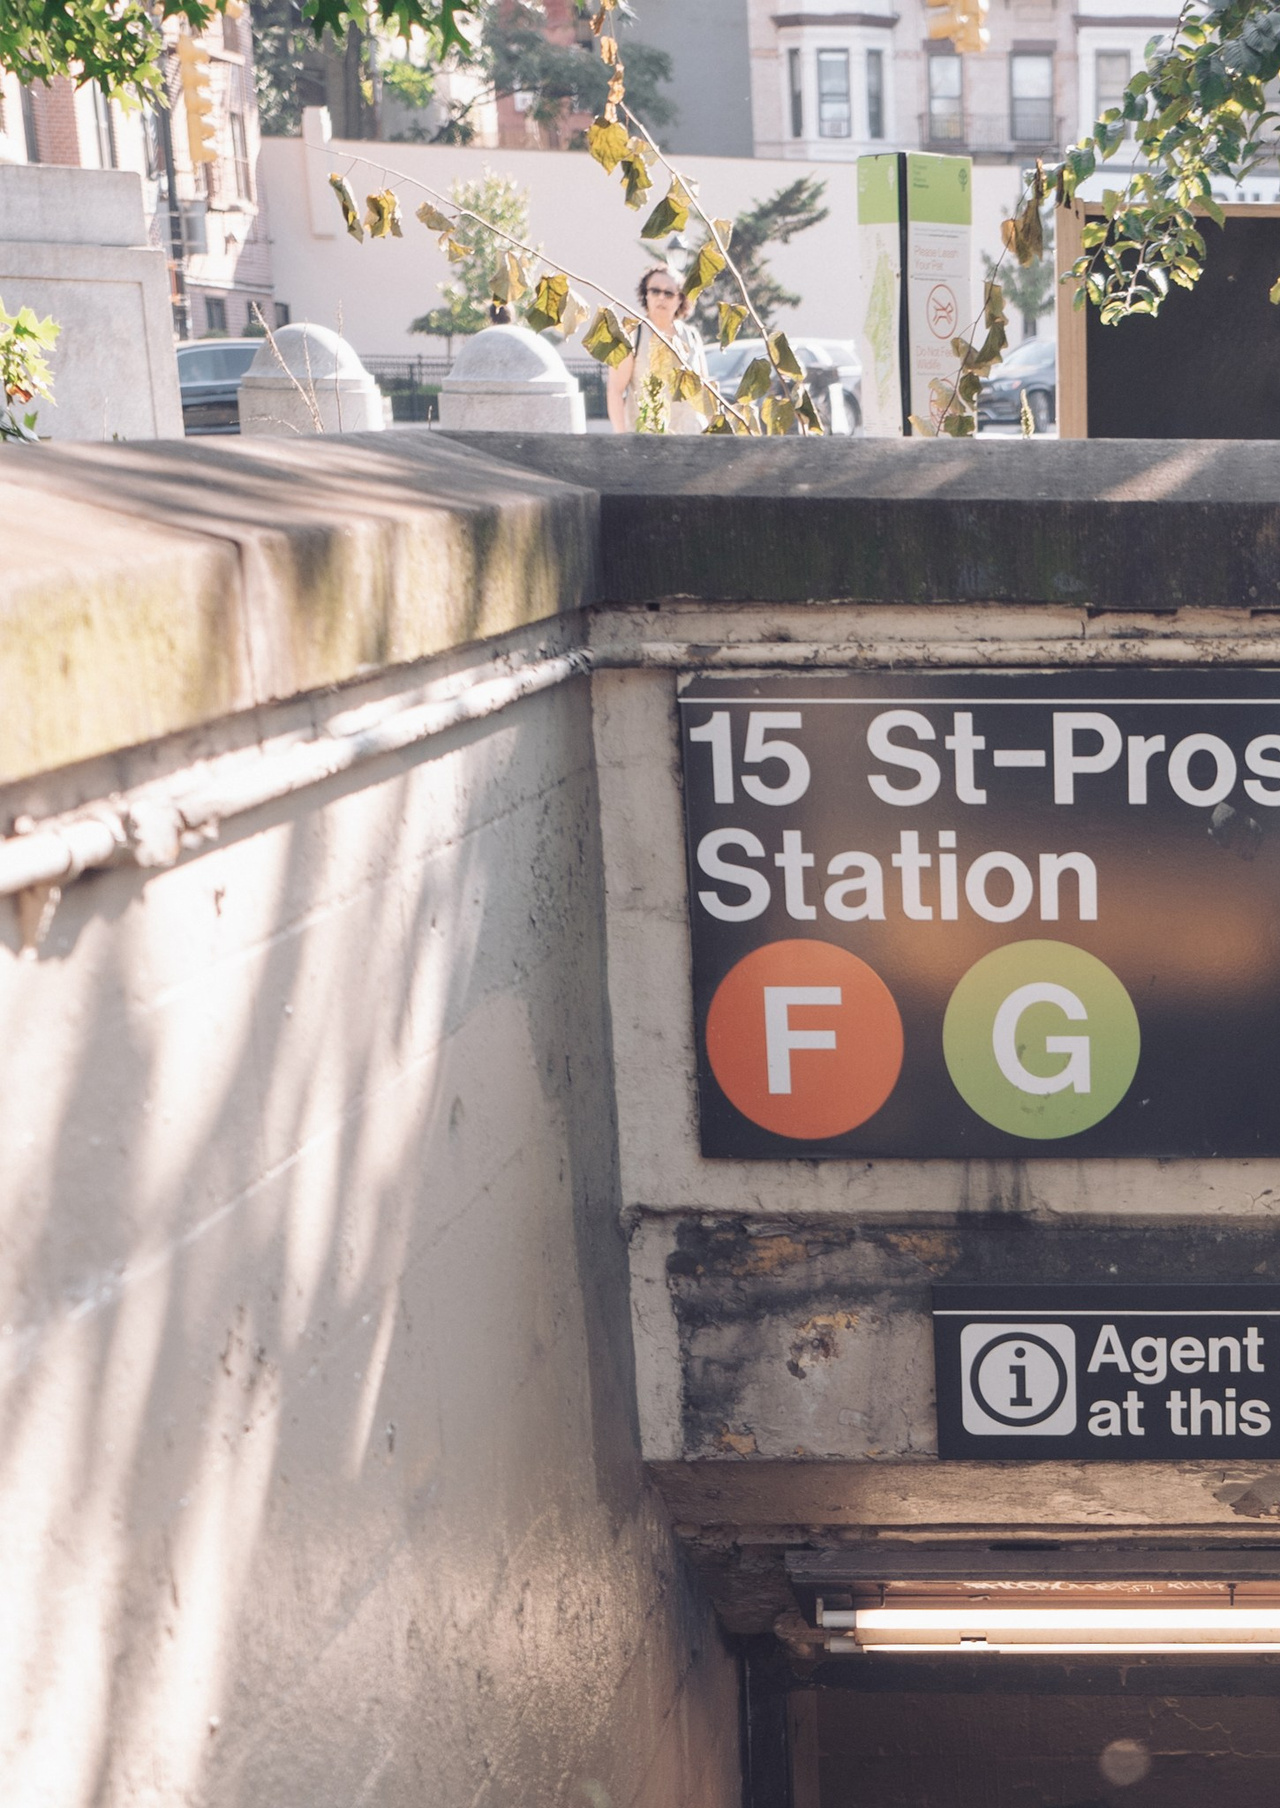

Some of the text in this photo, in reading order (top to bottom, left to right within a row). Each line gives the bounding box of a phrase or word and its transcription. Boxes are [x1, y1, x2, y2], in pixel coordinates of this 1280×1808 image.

[689, 711, 811, 806] 15
[697, 827, 1098, 923] Station
[764, 982, 1091, 1095] F G
[1087, 1324, 1265, 1385] Agent
[1088, 1390, 1145, 1437] at
[1165, 1388, 1271, 1437] this
